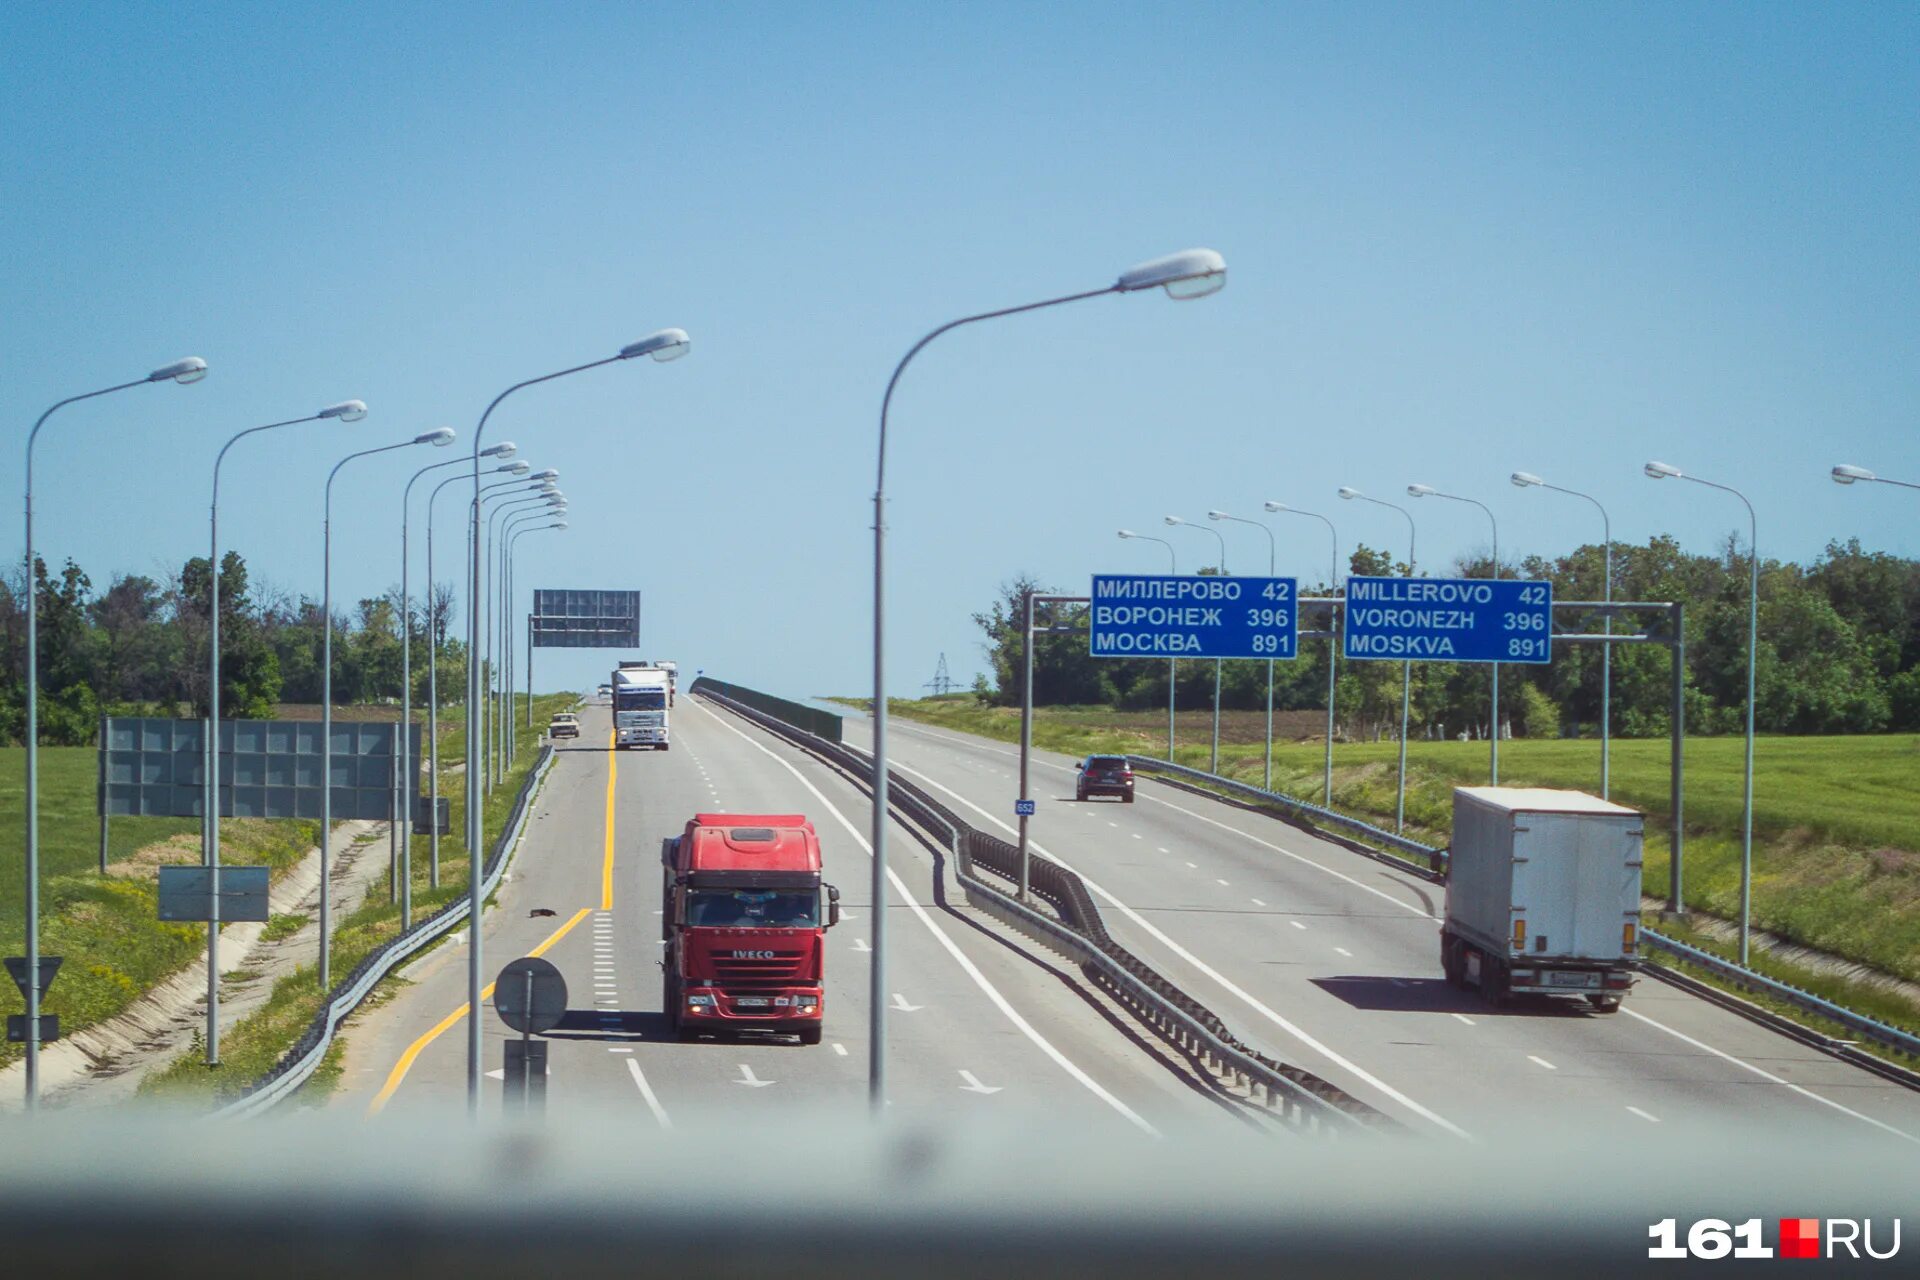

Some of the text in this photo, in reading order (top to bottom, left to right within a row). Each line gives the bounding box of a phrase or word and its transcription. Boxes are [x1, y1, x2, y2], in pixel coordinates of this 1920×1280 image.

[1097, 580, 1289, 601] МИЛЛЕРОВО 42
[1351, 582, 1546, 604] MILLEROVO 42
[1096, 606, 1289, 627] ВОРОНЕЖ 396
[1351, 608, 1545, 630] VORONEZH 396
[1096, 632, 1289, 653] МОСКВА 891
[1350, 634, 1545, 657] MOSKVA 891
[733, 950, 774, 959] IVECO
